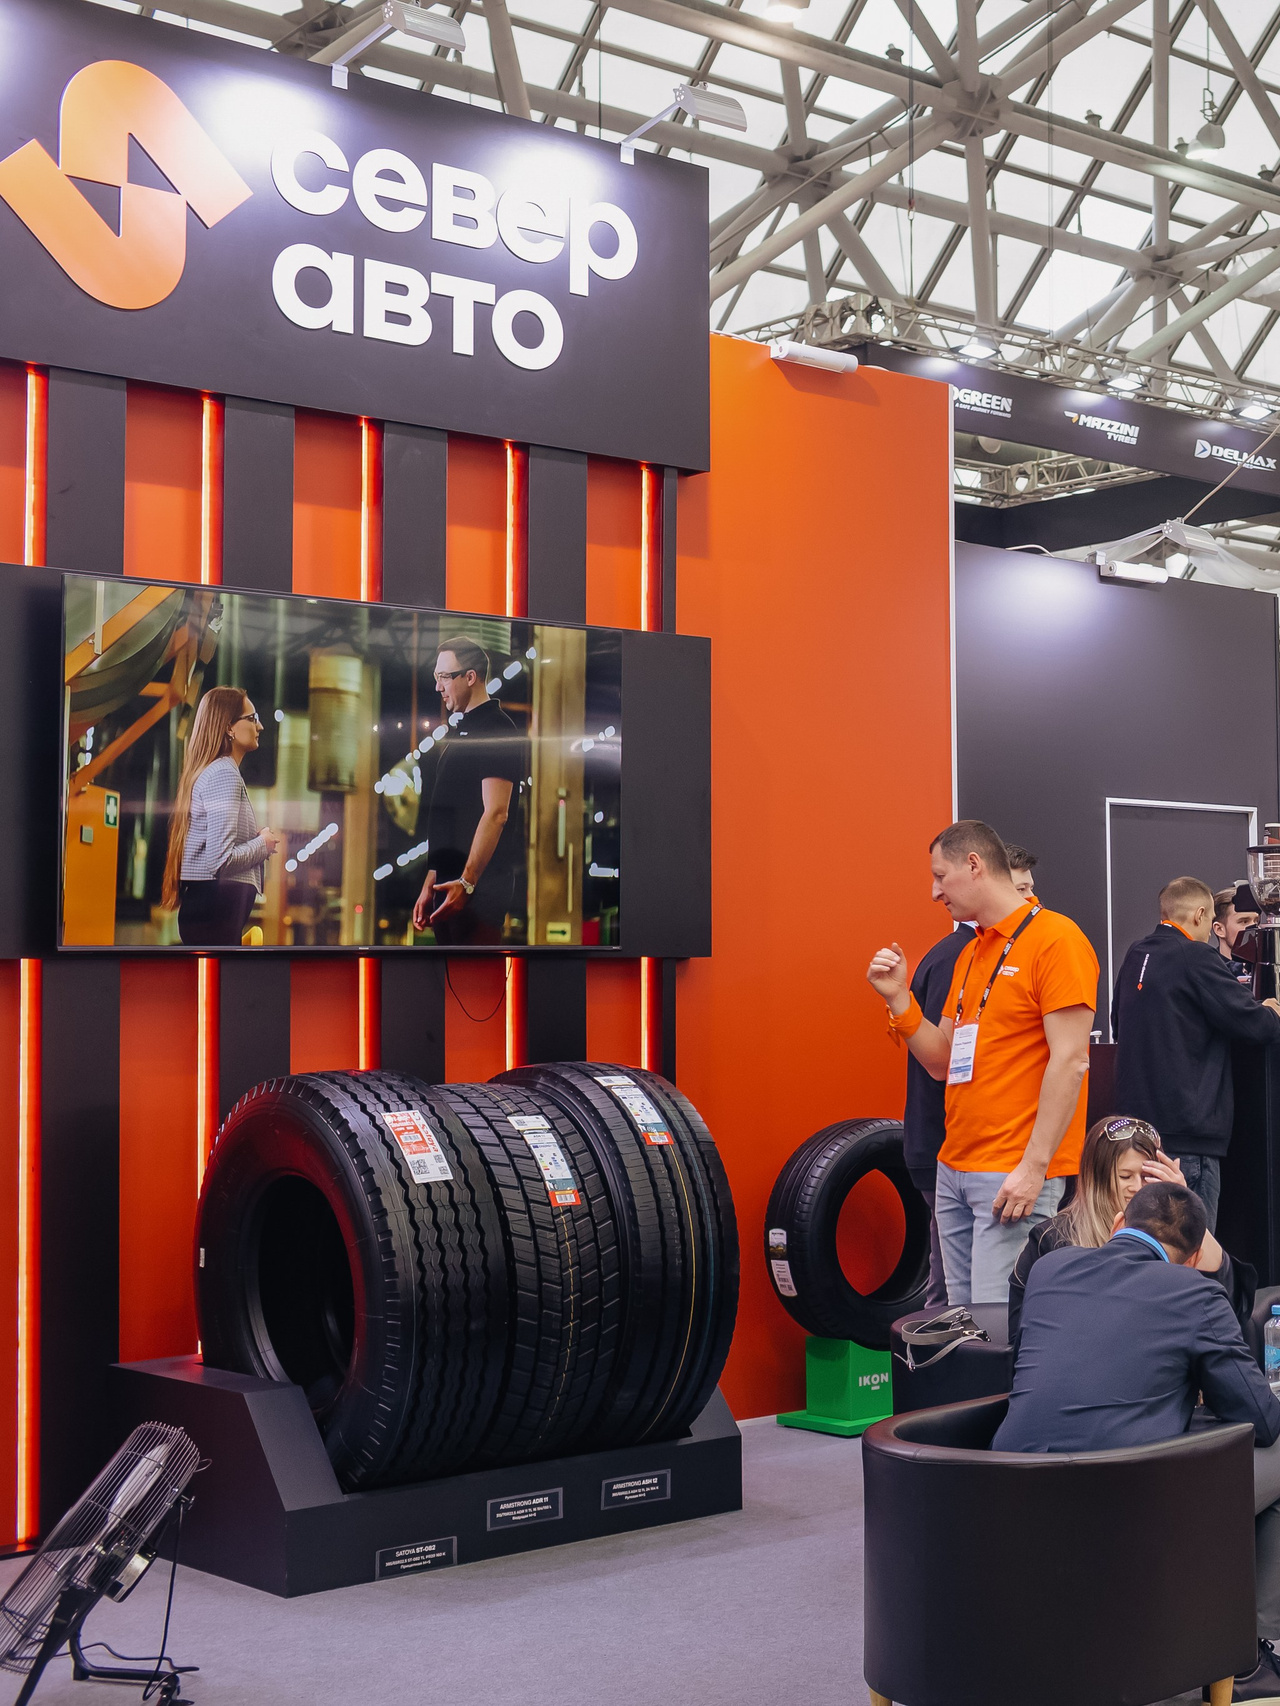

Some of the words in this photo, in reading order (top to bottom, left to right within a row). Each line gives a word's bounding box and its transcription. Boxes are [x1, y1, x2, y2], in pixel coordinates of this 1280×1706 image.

[270, 127, 639, 297] север
[271, 241, 565, 372] авто
[1078, 414, 1140, 438] MAZZINI
[1106, 432, 1137, 445] TYRES
[1212, 445, 1277, 470] DELMAX
[858, 1372, 889, 1387] IKON
[613, 1480, 641, 1490] ARMSTRONG
[500, 1500, 532, 1510] ARMSTRONG
[532, 1497, 543, 1505] ADR
[396, 1549, 415, 1557] SATOYA
[416, 1545, 435, 1553] ST-082
